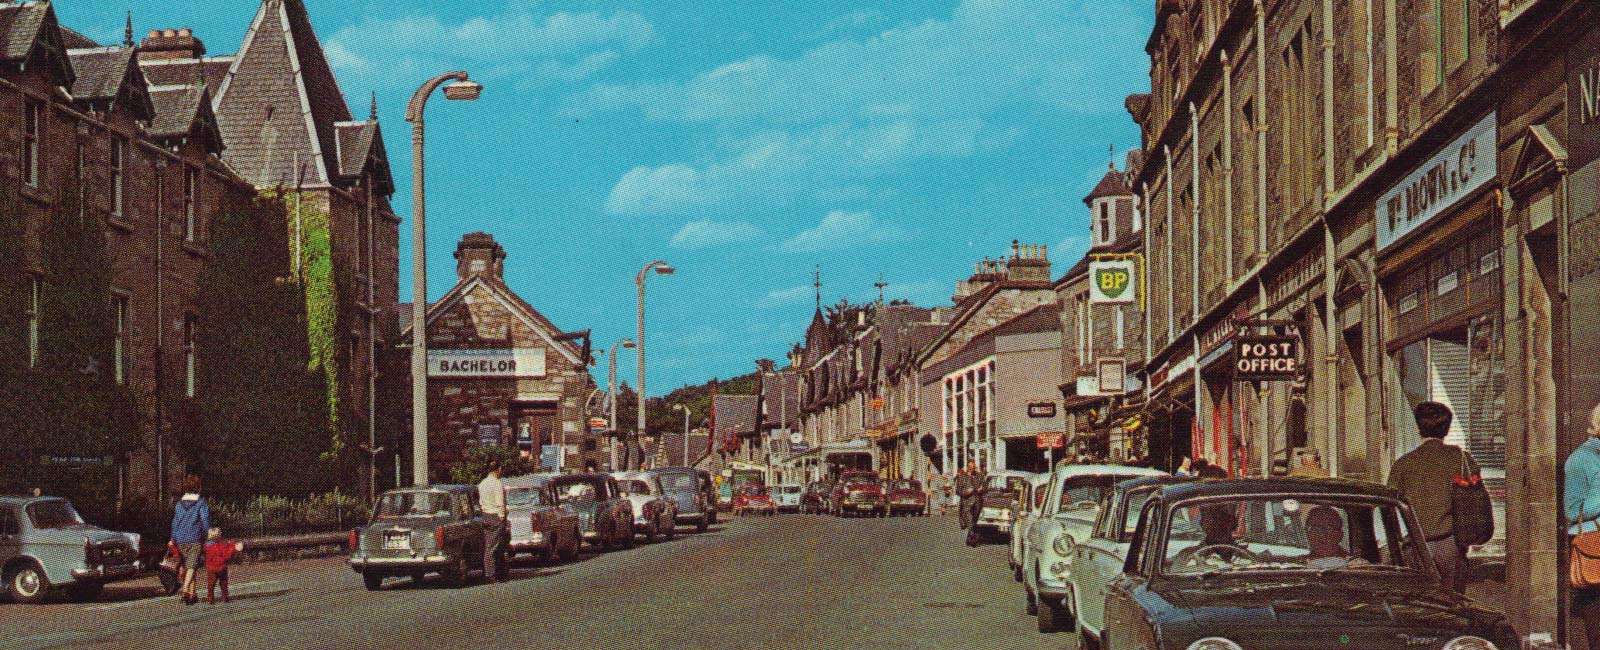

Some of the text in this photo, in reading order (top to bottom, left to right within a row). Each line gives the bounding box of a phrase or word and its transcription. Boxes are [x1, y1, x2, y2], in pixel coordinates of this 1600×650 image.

[1406, 160, 1448, 222] BROWN
[1101, 271, 1128, 290] BP
[1242, 343, 1291, 356] POST
[440, 359, 517, 373] BACHELOR
[1237, 358, 1296, 371] OFFICE
